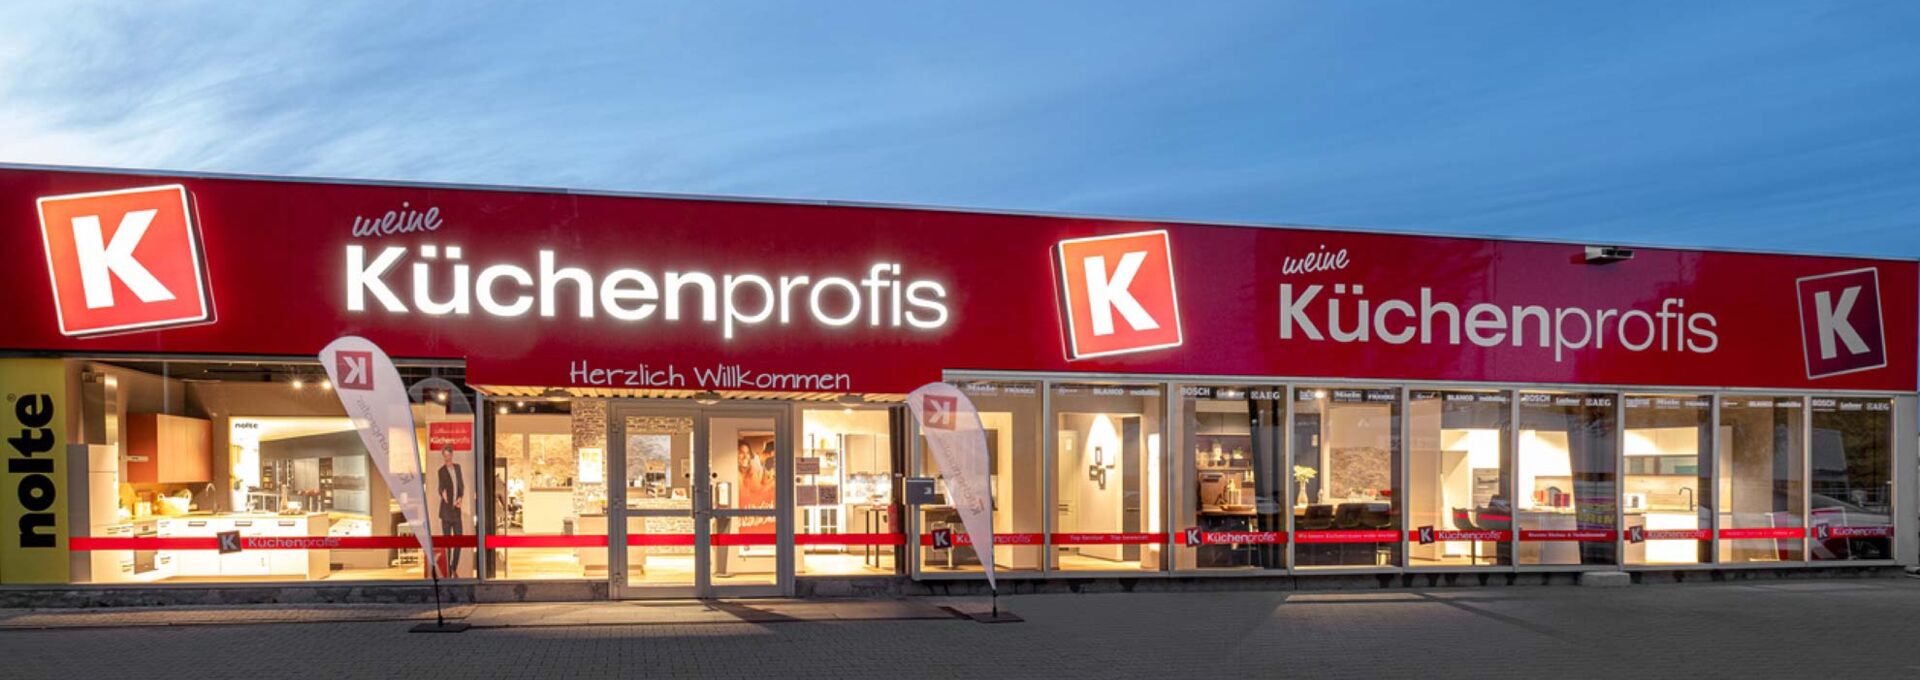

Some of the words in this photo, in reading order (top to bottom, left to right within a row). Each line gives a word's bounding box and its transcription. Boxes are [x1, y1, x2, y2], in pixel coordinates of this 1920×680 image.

[352, 201, 443, 237] meine
[71, 208, 177, 310] K
[1282, 244, 1350, 275] meine
[346, 245, 949, 338] Küchenprofis
[1083, 250, 1161, 337] K
[1279, 283, 1718, 362] Küchenprofis
[1814, 285, 1871, 360] K
[570, 360, 685, 387] Herzlich
[693, 363, 850, 390] Willkommen
[1181, 387, 1210, 396] BOSCH
[7, 393, 57, 548] nolte
[221, 534, 235, 550] K
[935, 531, 949, 546] K
[1187, 528, 1200, 543] K
[1420, 528, 1432, 542] K
[1631, 528, 1641, 541] K
[1818, 525, 1828, 538] K
